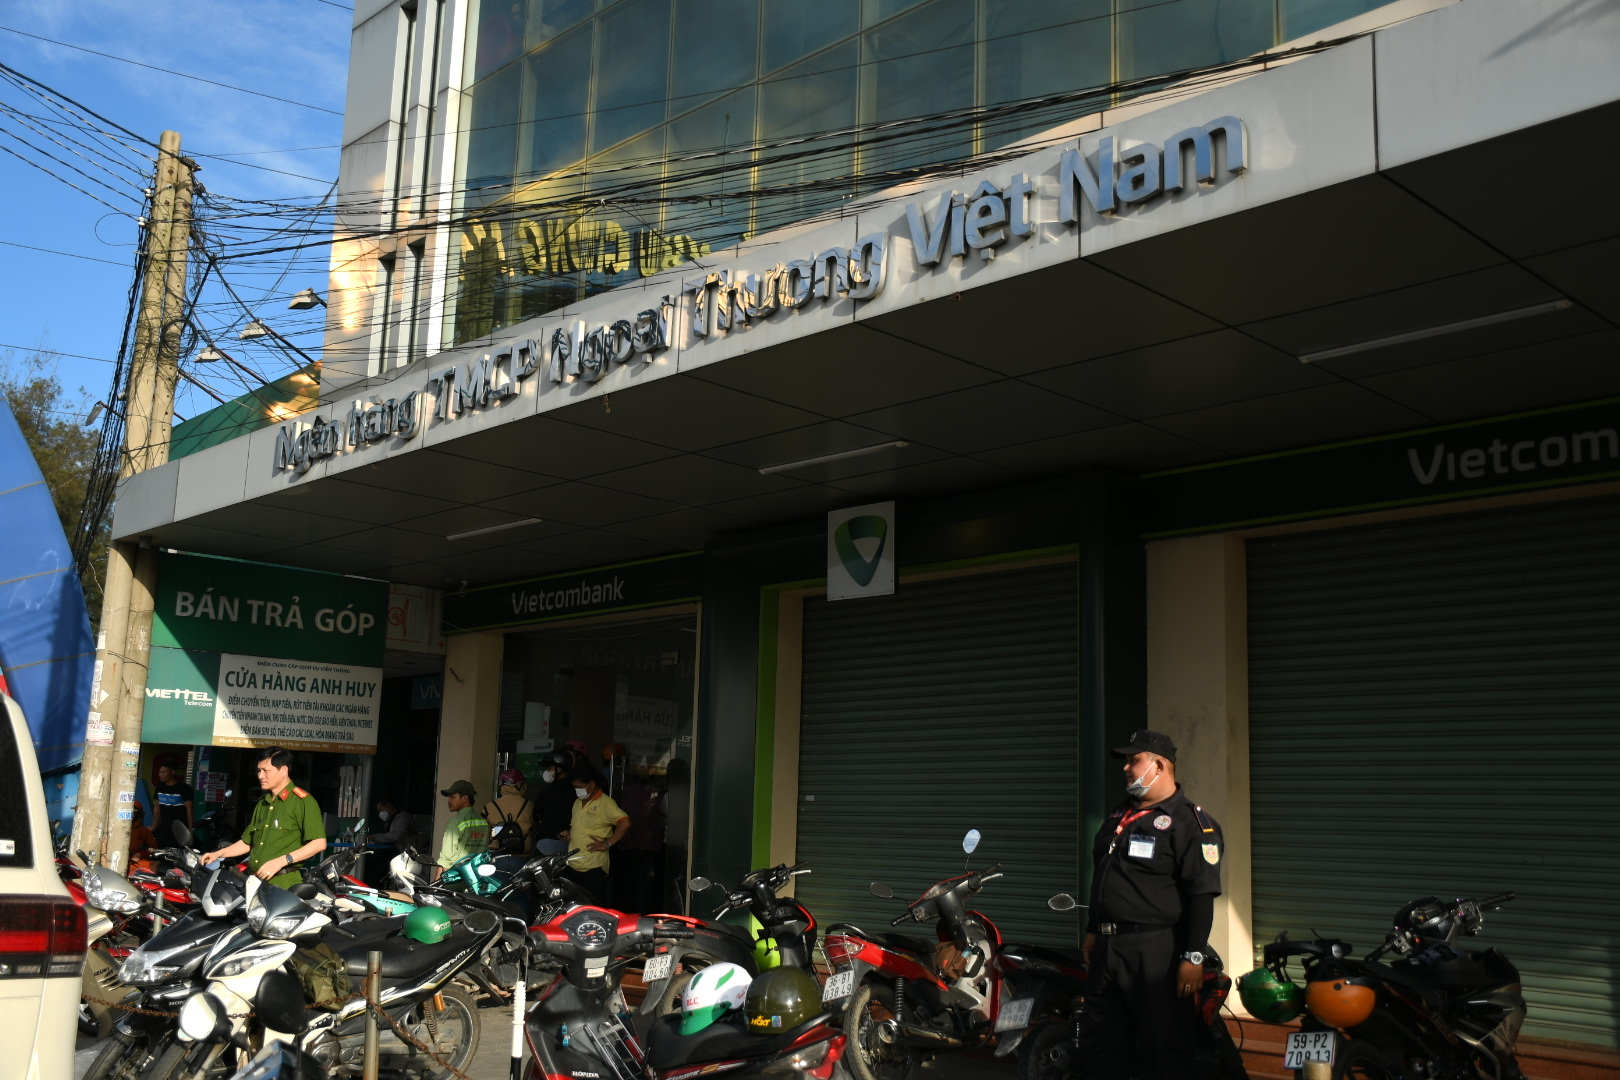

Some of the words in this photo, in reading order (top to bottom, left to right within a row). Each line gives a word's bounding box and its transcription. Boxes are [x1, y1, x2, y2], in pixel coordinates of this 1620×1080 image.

[275, 415, 344, 474] Ngân
[349, 394, 422, 440] hàng
[428, 338, 541, 419] TMCP
[549, 295, 675, 383] Ngoại
[684, 231, 888, 340] Thương
[905, 172, 1036, 268] Việt
[1059, 115, 1248, 228] Nam
[1407, 428, 1619, 486] Vietcom
[511, 575, 625, 615] Vietcombank
[174, 587, 240, 623] BÁN
[247, 595, 304, 630] TRẢ
[314, 603, 375, 637] GÓP
[225, 666, 258, 689] CỬA
[261, 670, 306, 693] HÀNG
[309, 677, 343, 695] ANH
[345, 680, 377, 698] HUY
[145, 687, 213, 702] VIETTEL
[184, 699, 213, 708] Telecom
[686, 997, 699, 1007] BLC
[1293, 1033, 1328, 1049] 59-P2
[571, 1070, 600, 1079] HONDA
